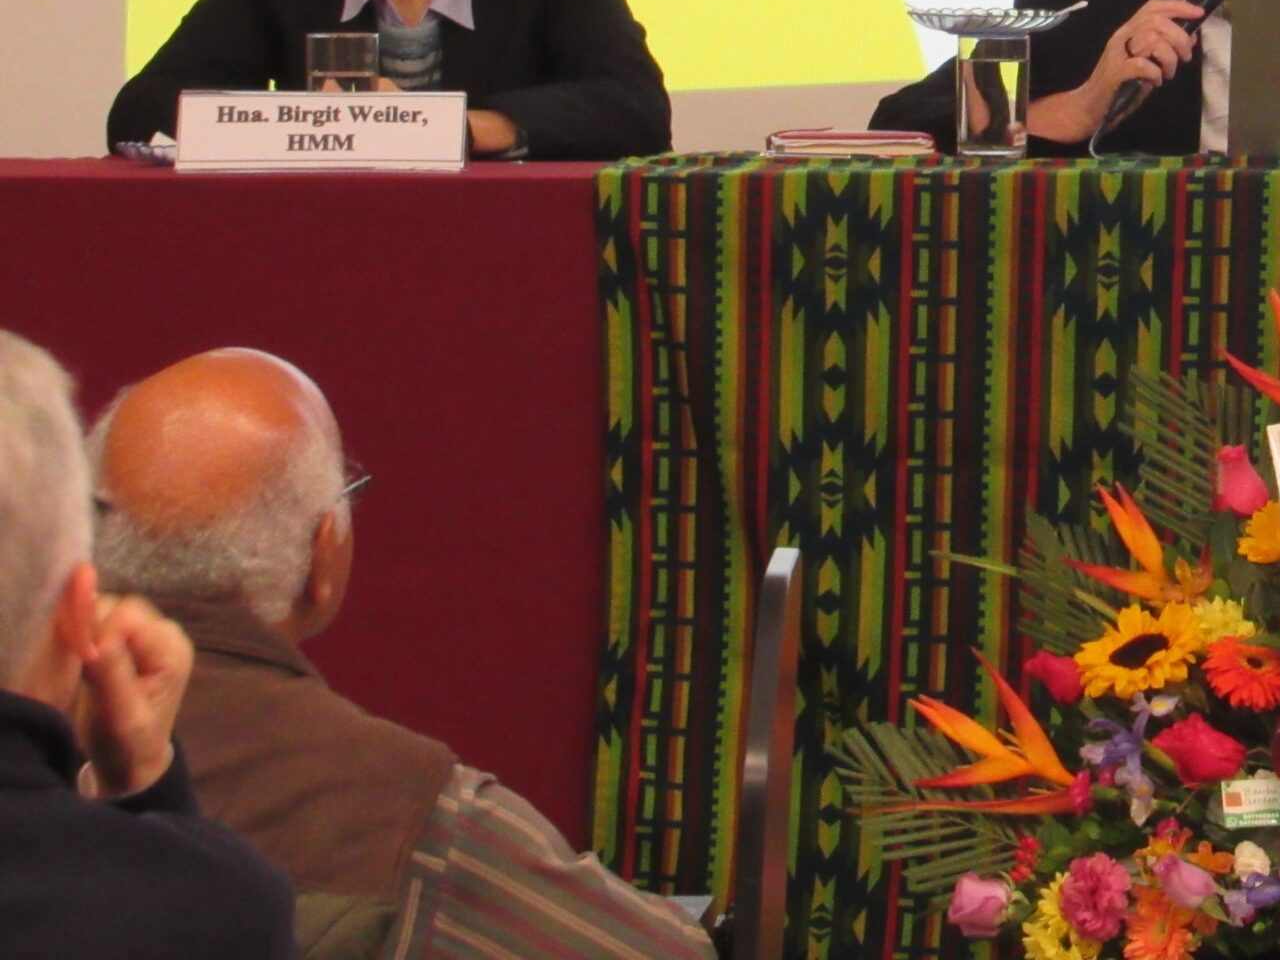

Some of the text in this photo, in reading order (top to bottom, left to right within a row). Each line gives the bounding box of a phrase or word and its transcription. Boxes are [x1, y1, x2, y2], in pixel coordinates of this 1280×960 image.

[216, 105, 429, 127] Hna. Birgit Weiler,
[286, 133, 355, 152] HMM
